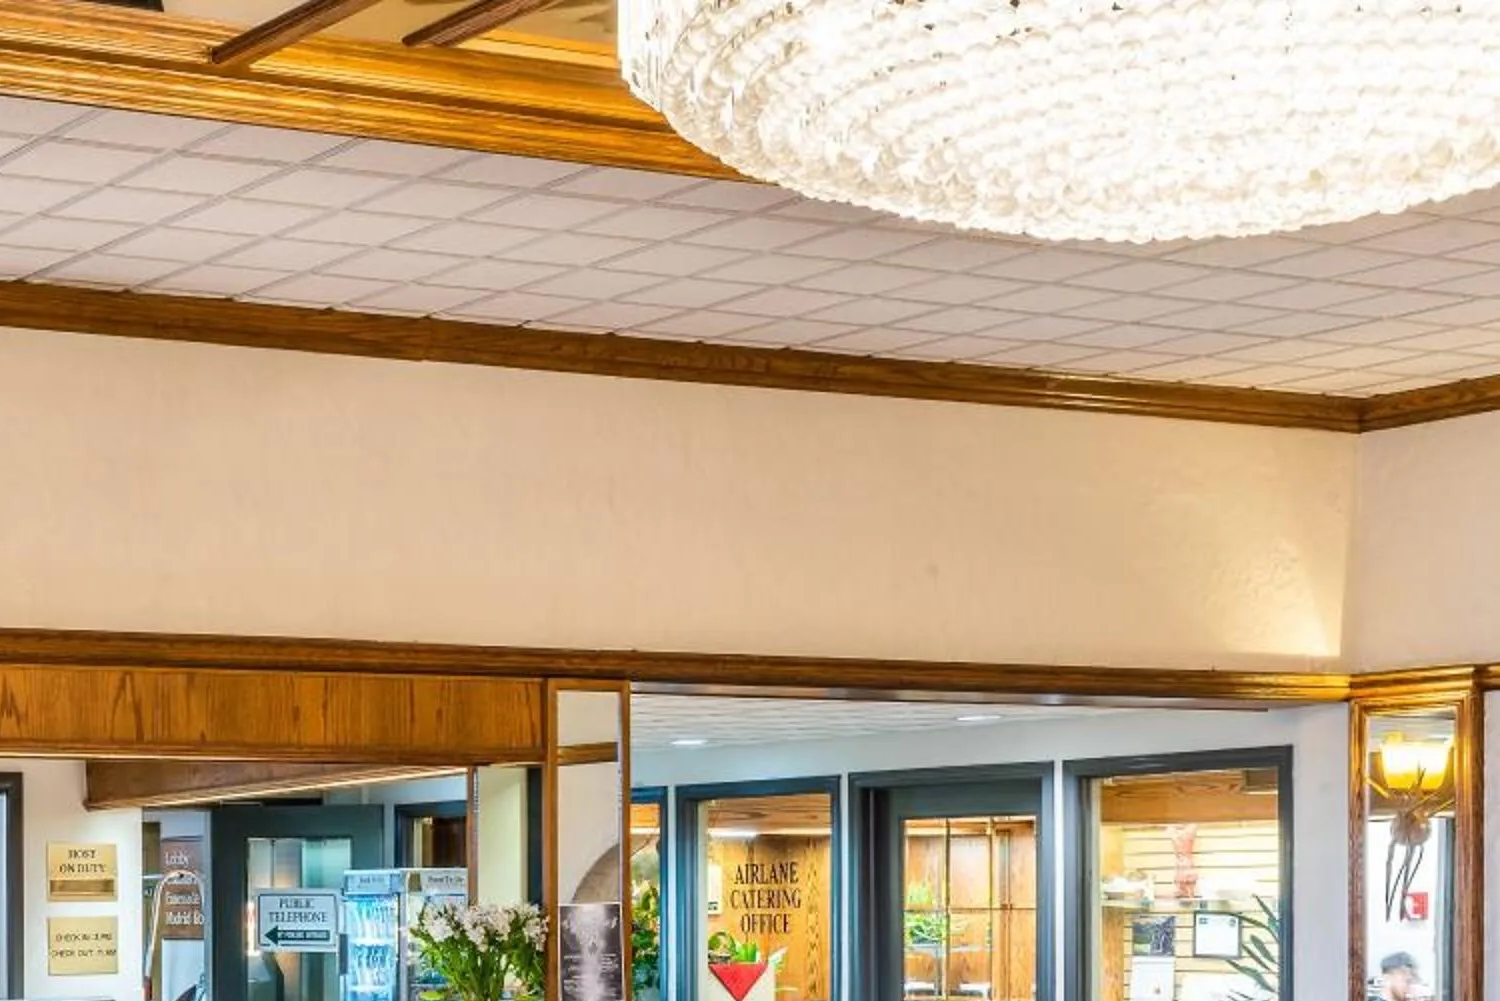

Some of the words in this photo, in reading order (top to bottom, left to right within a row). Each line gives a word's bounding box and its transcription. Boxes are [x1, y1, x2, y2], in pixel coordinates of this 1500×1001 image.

[68, 849, 97, 859] HOST
[59, 863, 75, 873] ON
[77, 863, 106, 873] DUTY
[734, 862, 799, 885] AIRLANE
[279, 898, 315, 909] PUBLIC
[730, 889, 801, 909] CATERING
[268, 911, 328, 923] TELEPHONE
[741, 913, 792, 934] OFFICE
